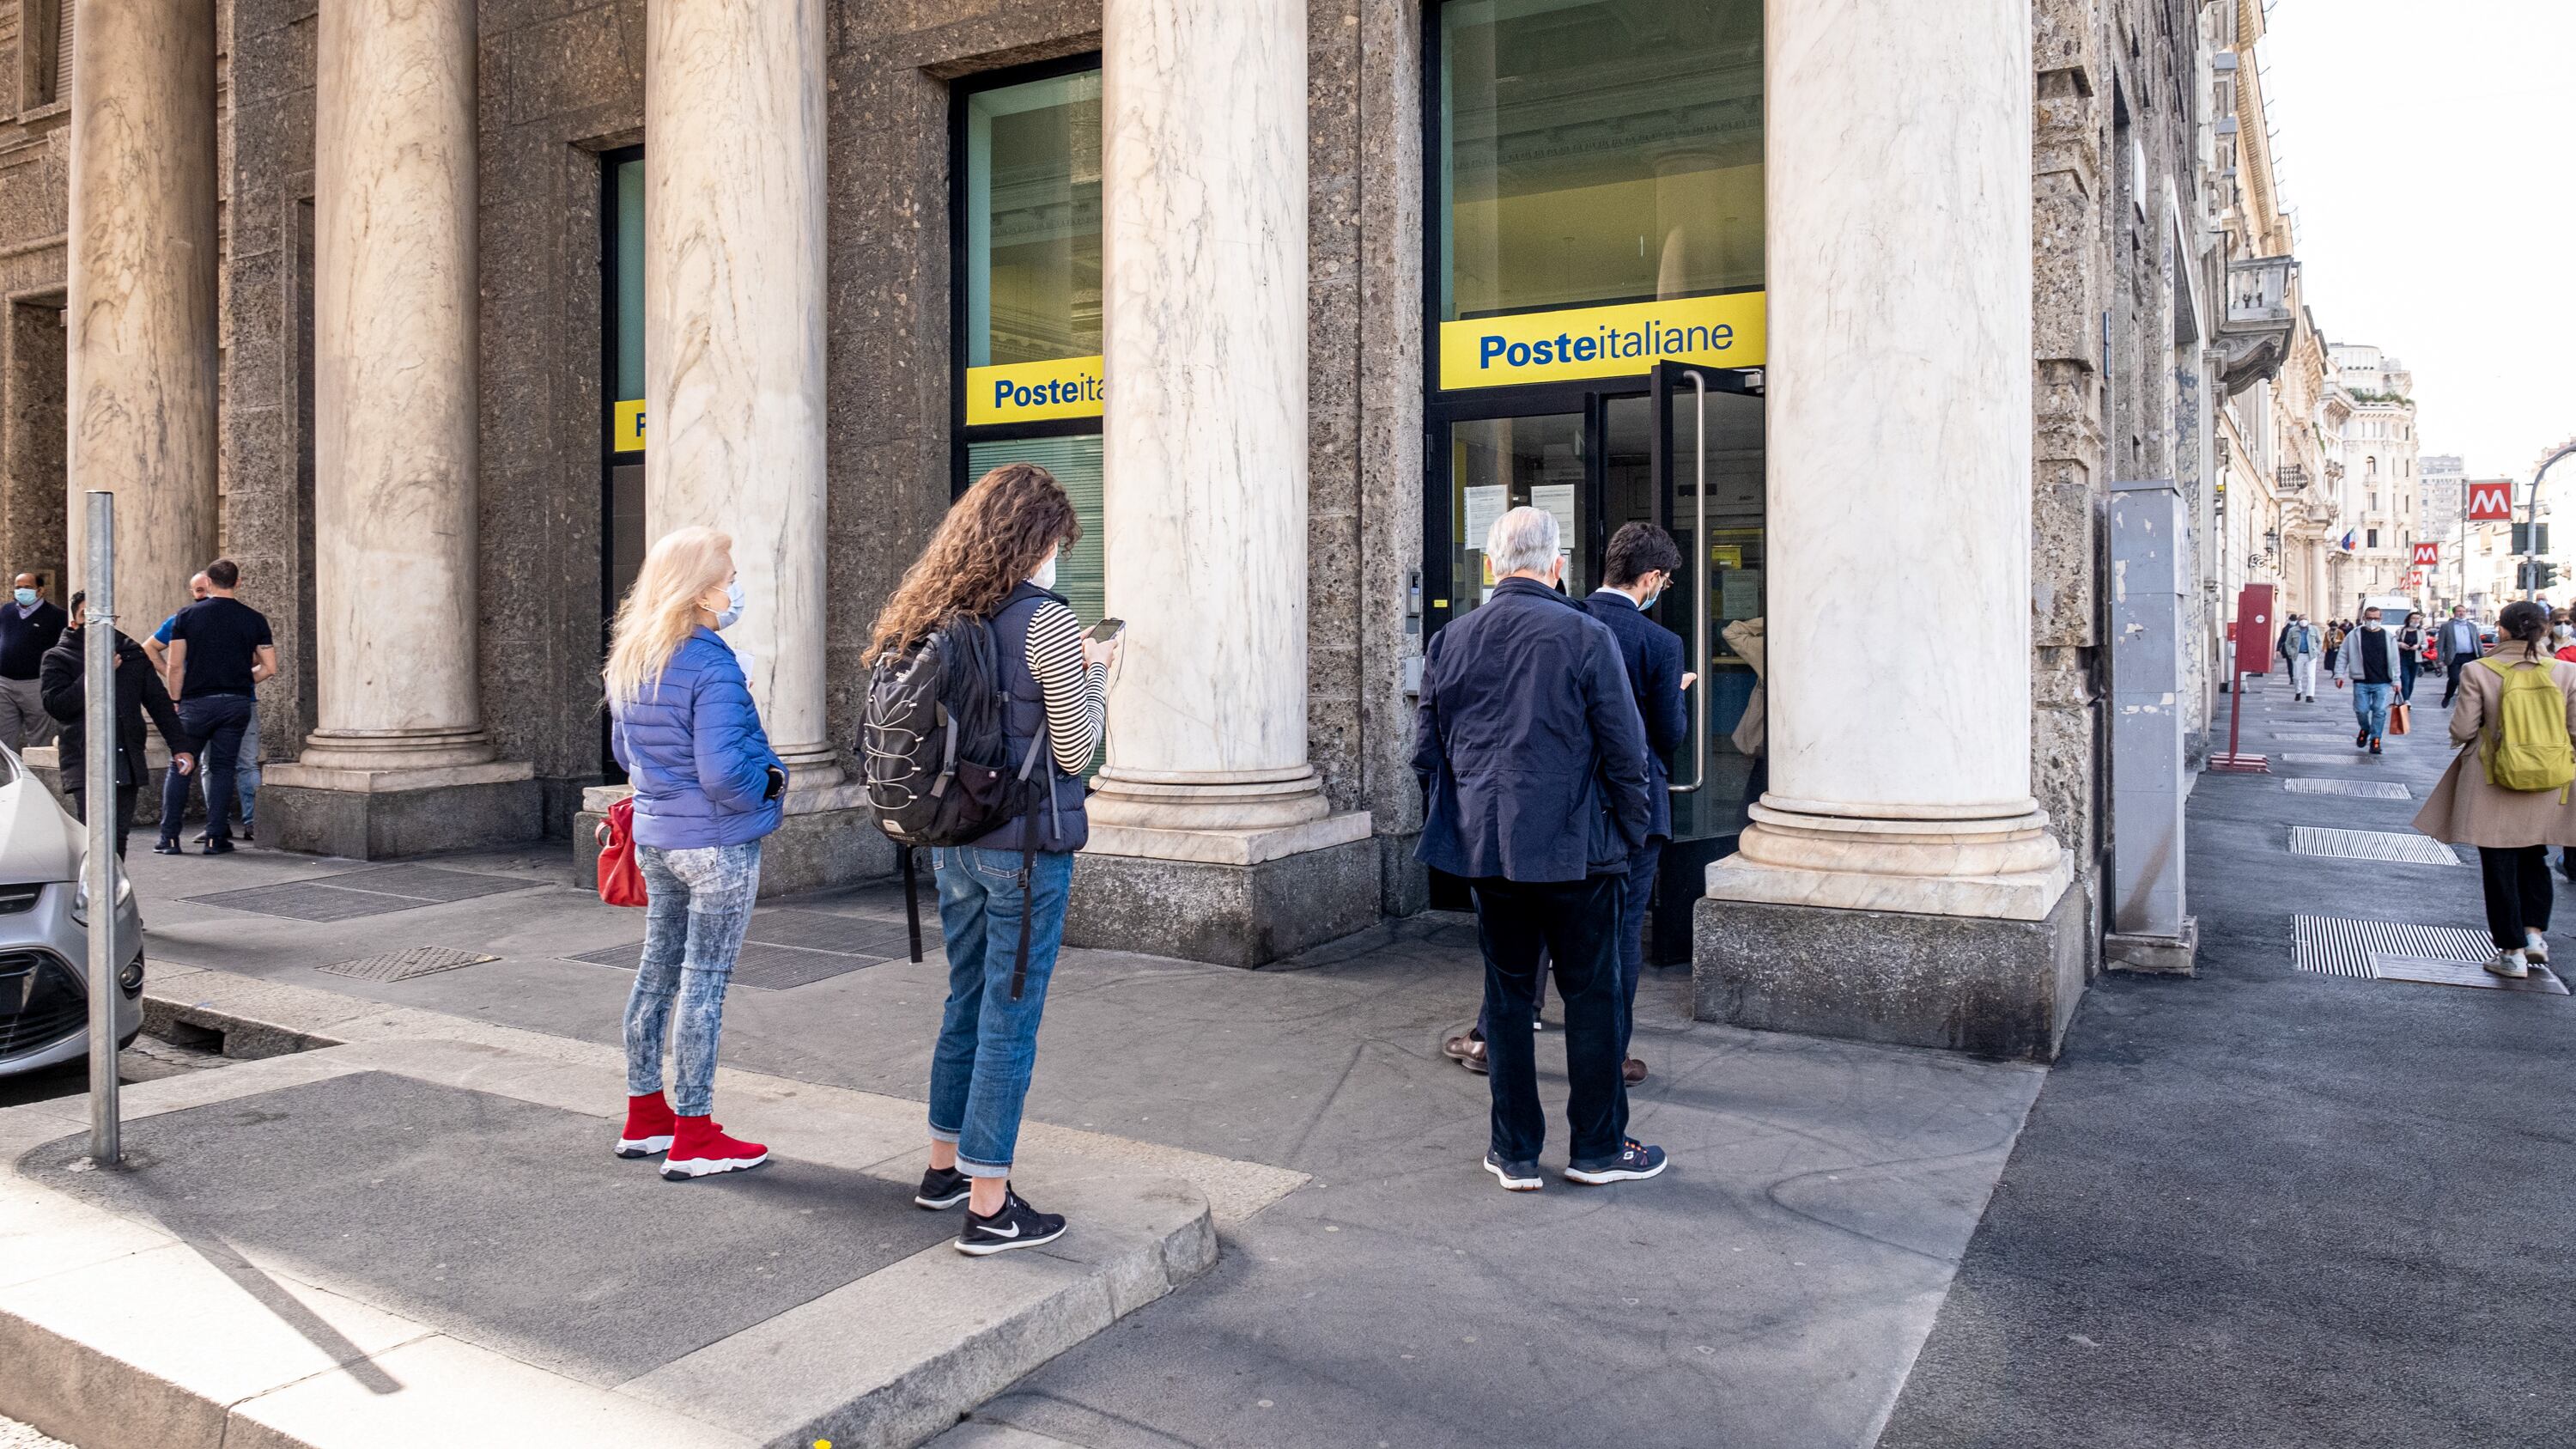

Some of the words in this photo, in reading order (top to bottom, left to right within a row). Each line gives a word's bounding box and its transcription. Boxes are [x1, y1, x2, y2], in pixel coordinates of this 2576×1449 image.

[1479, 320, 1734, 369] Posteitaliane
[2470, 490, 2509, 514] M
[2415, 547, 2437, 561] M
